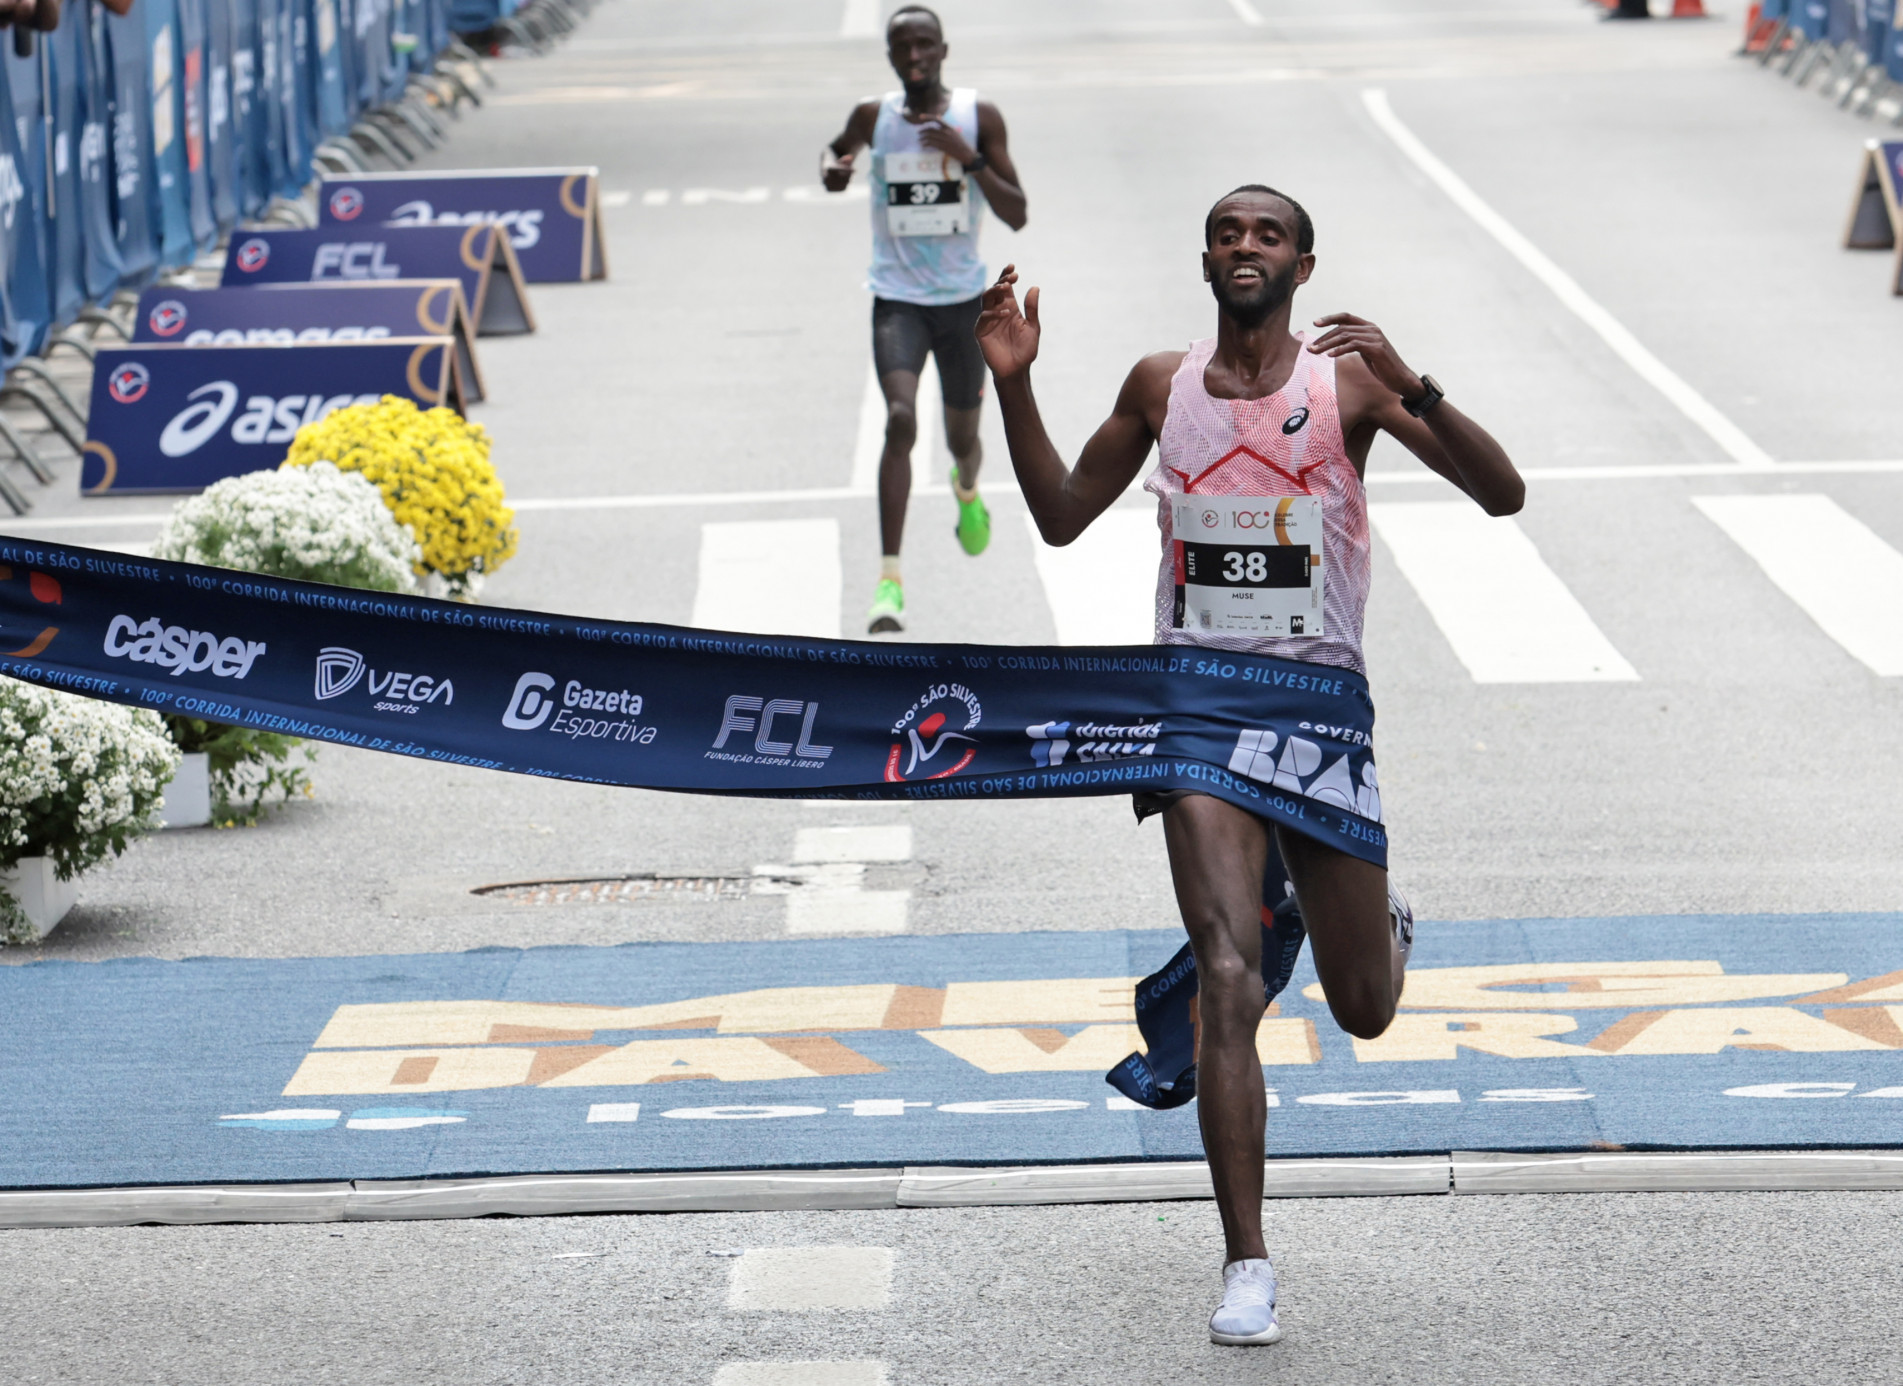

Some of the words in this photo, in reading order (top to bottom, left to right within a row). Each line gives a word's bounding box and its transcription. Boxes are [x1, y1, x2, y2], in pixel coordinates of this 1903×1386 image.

[910, 183, 940, 204] 39
[310, 242, 401, 276] FCL
[231, 394, 381, 444] asi
[1187, 551, 1196, 576] ELITE
[1222, 551, 1268, 582] 38
[1232, 592, 1254, 600] MUSE
[24, 550, 44, 565] DE
[49, 551, 81, 570] SÃO
[86, 559, 160, 582] SILVESTRE
[222, 581, 289, 603] CORRIDA
[295, 592, 416, 621] INTERNACIONAL
[421, 609, 439, 622] DE
[444, 609, 474, 628] SÃO
[479, 616, 550, 636] SILVESTRE
[611, 631, 677, 649] CORRIDA
[683, 638, 800, 660] INTERNACIONAL
[808, 649, 826, 662] DE
[830, 648, 860, 665] SÃO
[864, 653, 938, 668] SILVESTRE
[1000, 657, 1060, 671] CORRIDA
[1063, 656, 1165, 673] INTERNACIONAL
[1168, 658, 1188, 673] DE
[1195, 658, 1236, 679] SÃO
[1242, 667, 1344, 696] SILVESTRE
[368, 668, 454, 706] VEGA
[563, 680, 644, 716] Gazeta
[12, 663, 42, 680] SÃO
[46, 670, 118, 696] SILVESTRE
[175, 695, 242, 721] CORRIDA
[243, 709, 366, 748] INTERNACIONAL
[368, 736, 391, 750] DE
[394, 738, 426, 758] SÃO
[429, 749, 503, 772] SILVESTRE
[373, 701, 420, 715] sports
[920, 684, 948, 708] SÃO
[949, 683, 982, 731] SILVESTRE
[550, 709, 658, 745] Esportiva
[711, 694, 834, 759] FCL
[704, 751, 754, 764] FUNDAÇÃO
[754, 755, 791, 767] CÁSPER
[790, 757, 825, 769] LÍBERO
[1042, 762, 1169, 790] INTERNACIONAL
[1228, 728, 1385, 824] BRAS
[904, 777, 978, 799] SILVESTRE
[983, 773, 1012, 794] SÃO
[1017, 774, 1037, 789] DE
[1175, 761, 1260, 799] CORRIDA
[1338, 818, 1387, 848] VESTRE
[1150, 955, 1196, 998] CORRID
[313, 958, 1903, 1048] MEG
[917, 1005, 1903, 1075] VIRA
[281, 1036, 864, 1096] DA
